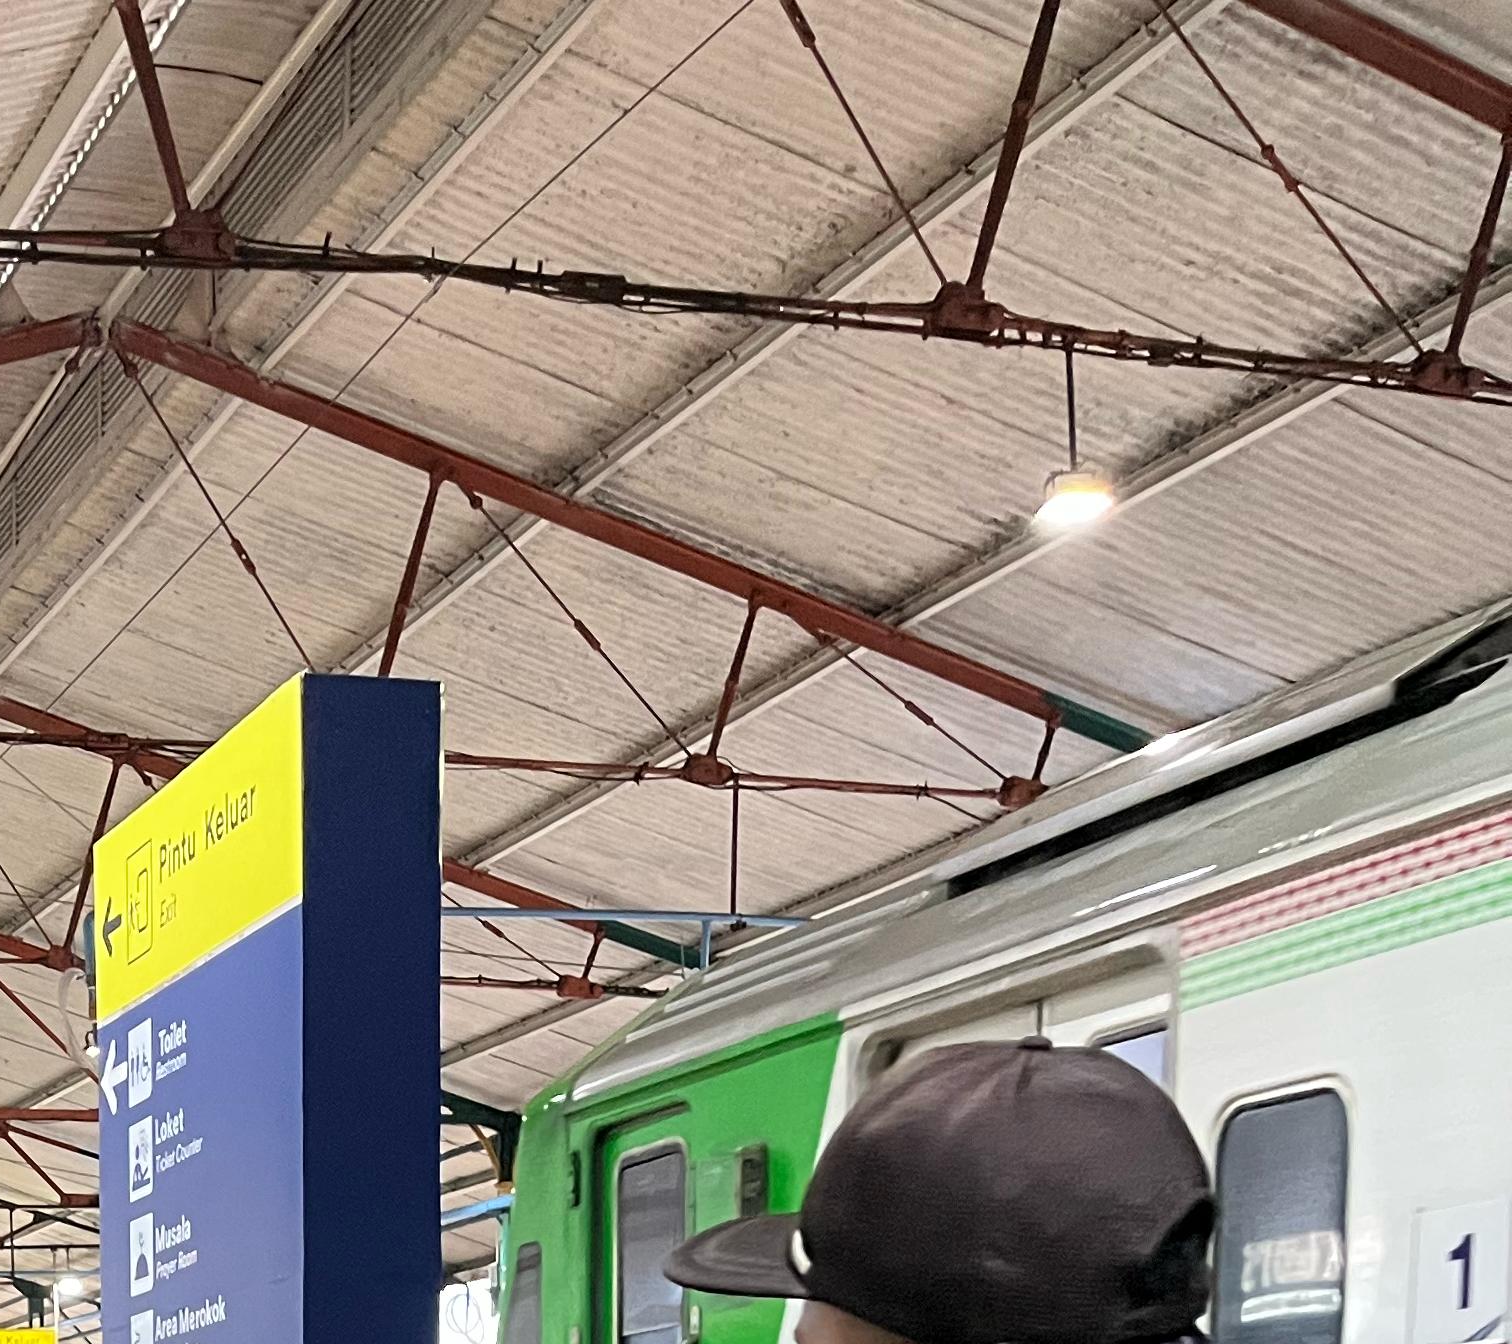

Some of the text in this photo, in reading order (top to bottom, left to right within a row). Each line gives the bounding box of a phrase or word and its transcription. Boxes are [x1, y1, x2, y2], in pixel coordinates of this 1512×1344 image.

[159, 784, 257, 883] Pintu Keluar
[159, 892, 177, 928] Exit
[158, 1019, 187, 1057] Toilet
[154, 1107, 184, 1145] Loket
[1447, 1232, 1477, 1310] 1
[154, 1294, 226, 1342] Area Merokok
